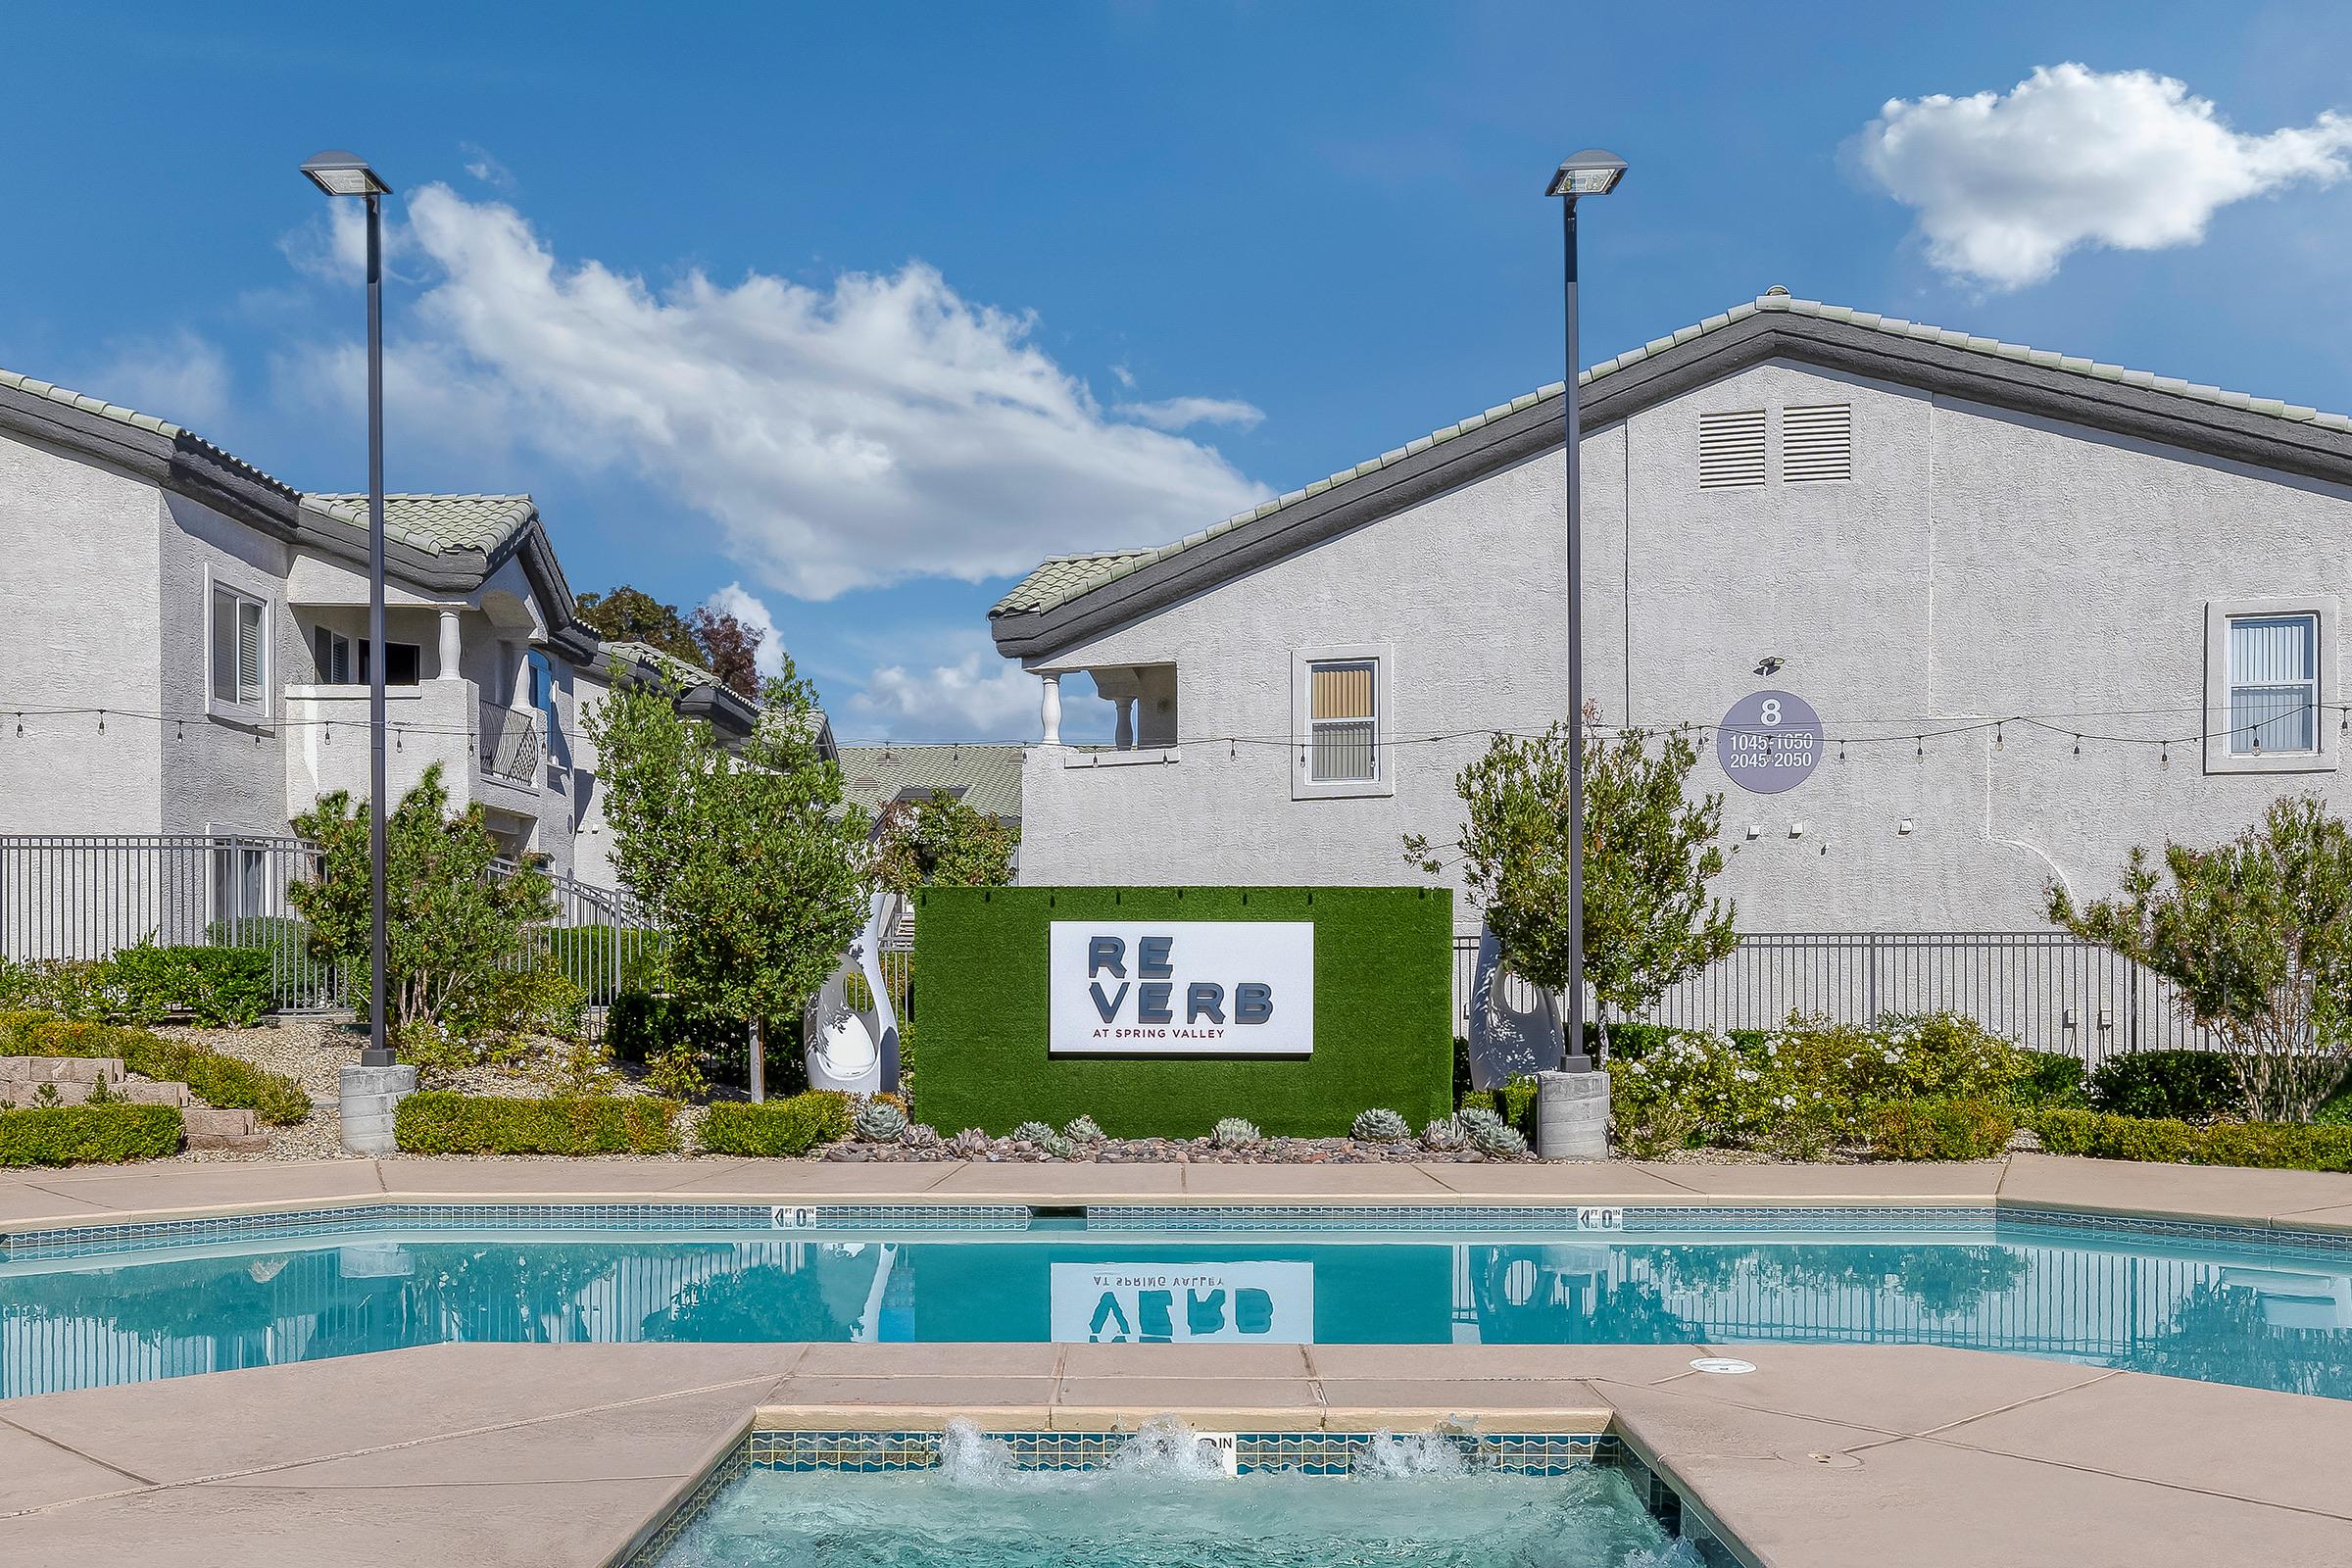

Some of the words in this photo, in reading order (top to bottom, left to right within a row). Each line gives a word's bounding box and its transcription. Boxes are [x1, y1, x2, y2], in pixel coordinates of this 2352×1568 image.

[1760, 698, 1783, 726] 8
[1089, 936, 1173, 979] RE
[1089, 982, 1274, 1025] VERB
[1093, 1029, 1109, 1038] AT
[1115, 1029, 1166, 1038] SPRING
[1172, 1029, 1224, 1038] VALLEY
[1219, 1438, 1232, 1448] IN
